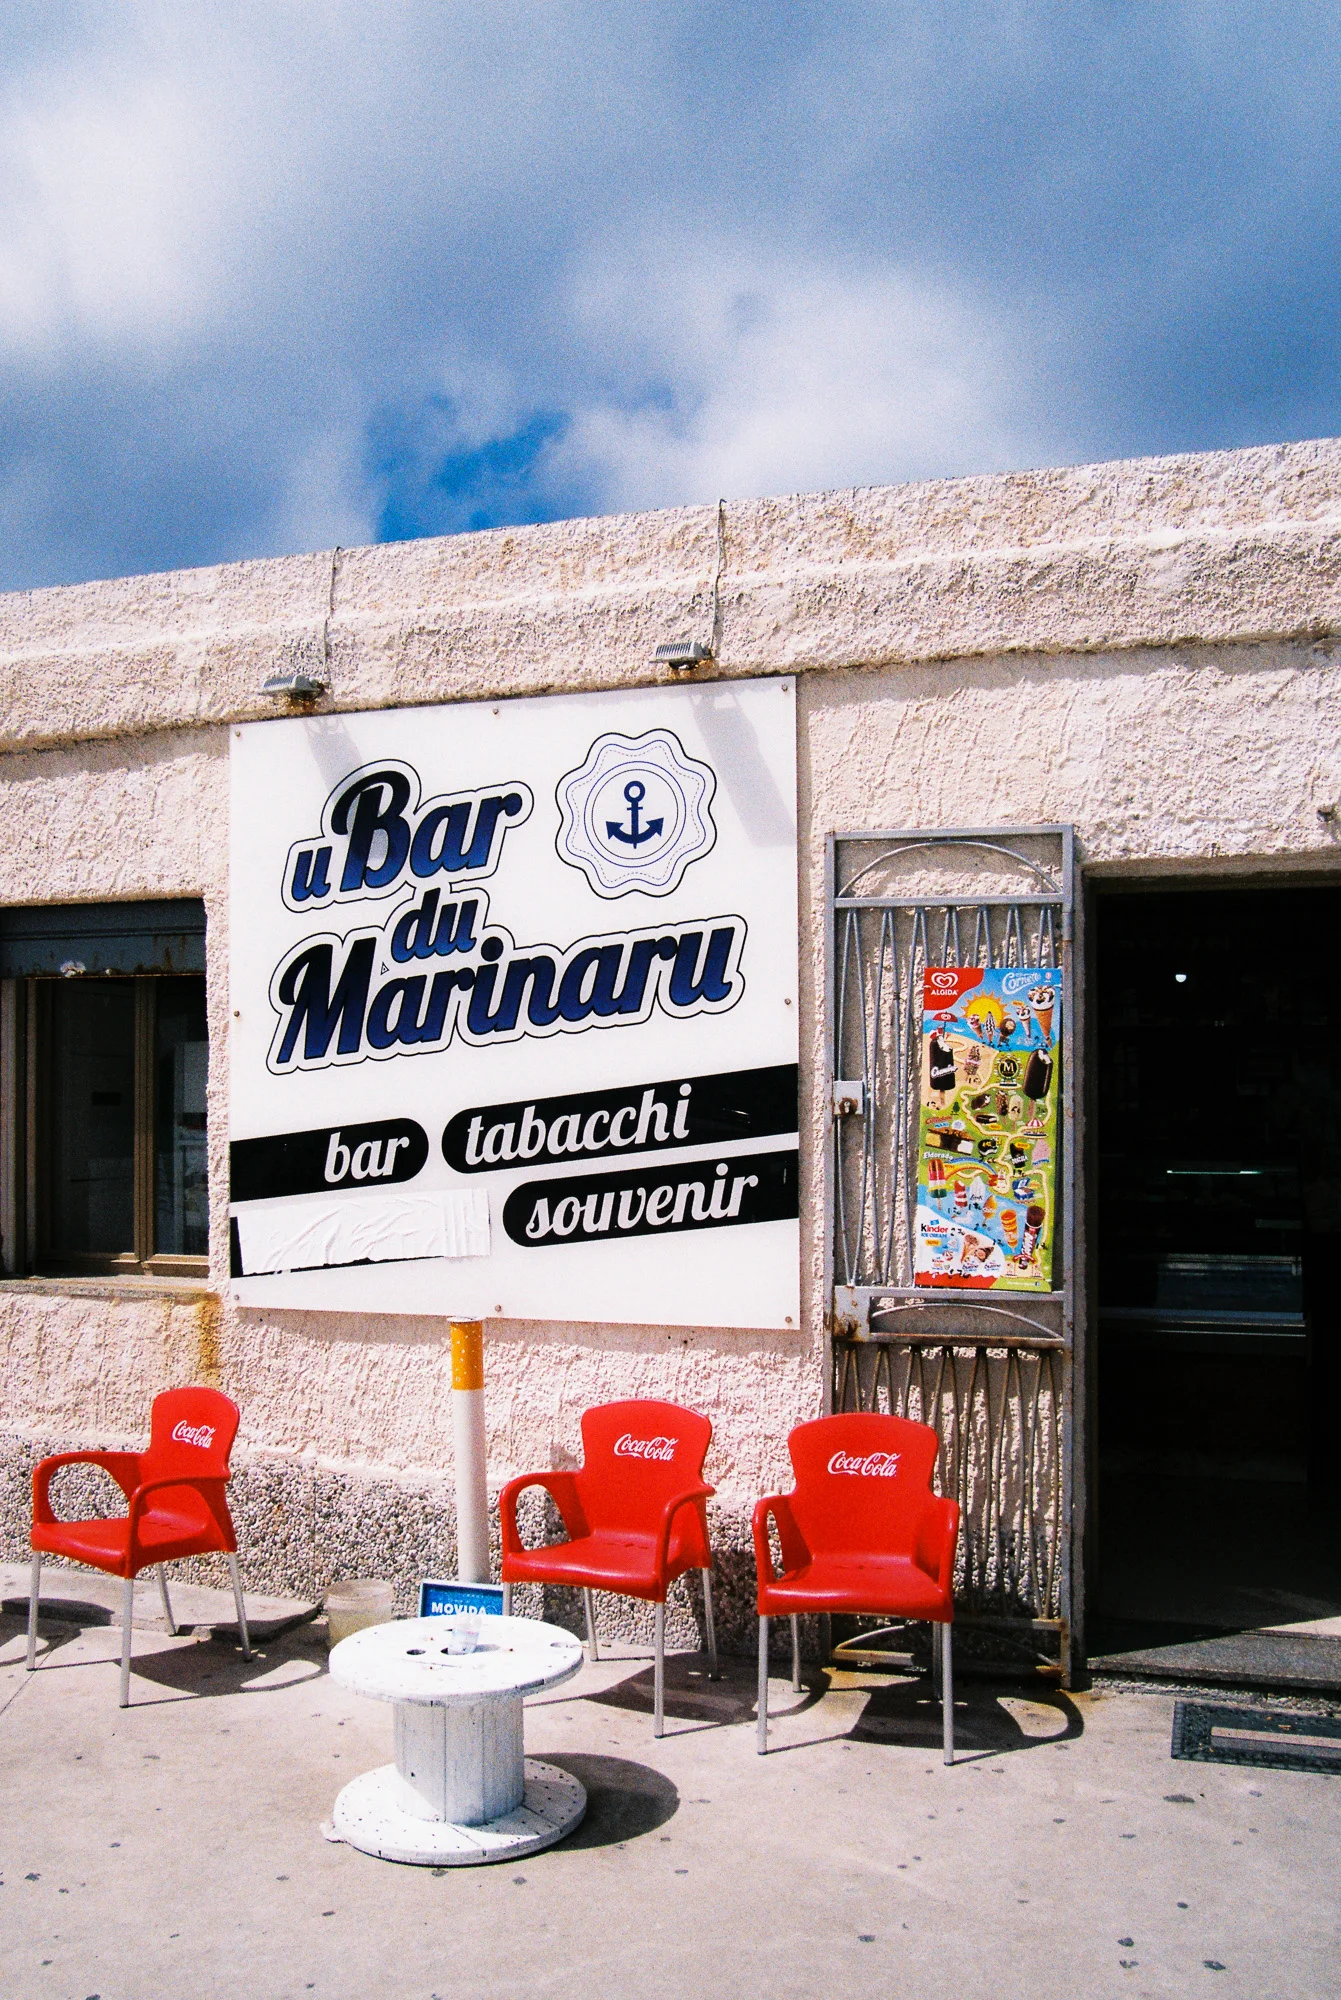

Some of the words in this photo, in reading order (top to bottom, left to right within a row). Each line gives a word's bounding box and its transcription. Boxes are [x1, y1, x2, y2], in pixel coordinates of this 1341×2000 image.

[291, 844, 330, 901] u
[331, 770, 523, 891] Bar
[390, 889, 478, 962] du
[276, 926, 736, 1065] Marinaru
[465, 1083, 691, 1166] tabacchi
[324, 1131, 410, 1184] bar
[525, 1162, 760, 1240] souvenir
[172, 1420, 216, 1449] Coca-Cola
[614, 1433, 679, 1461] Coca-Cola
[827, 1450, 901, 1478] Coca-Cola
[431, 1601, 487, 1616] MOVIDA
